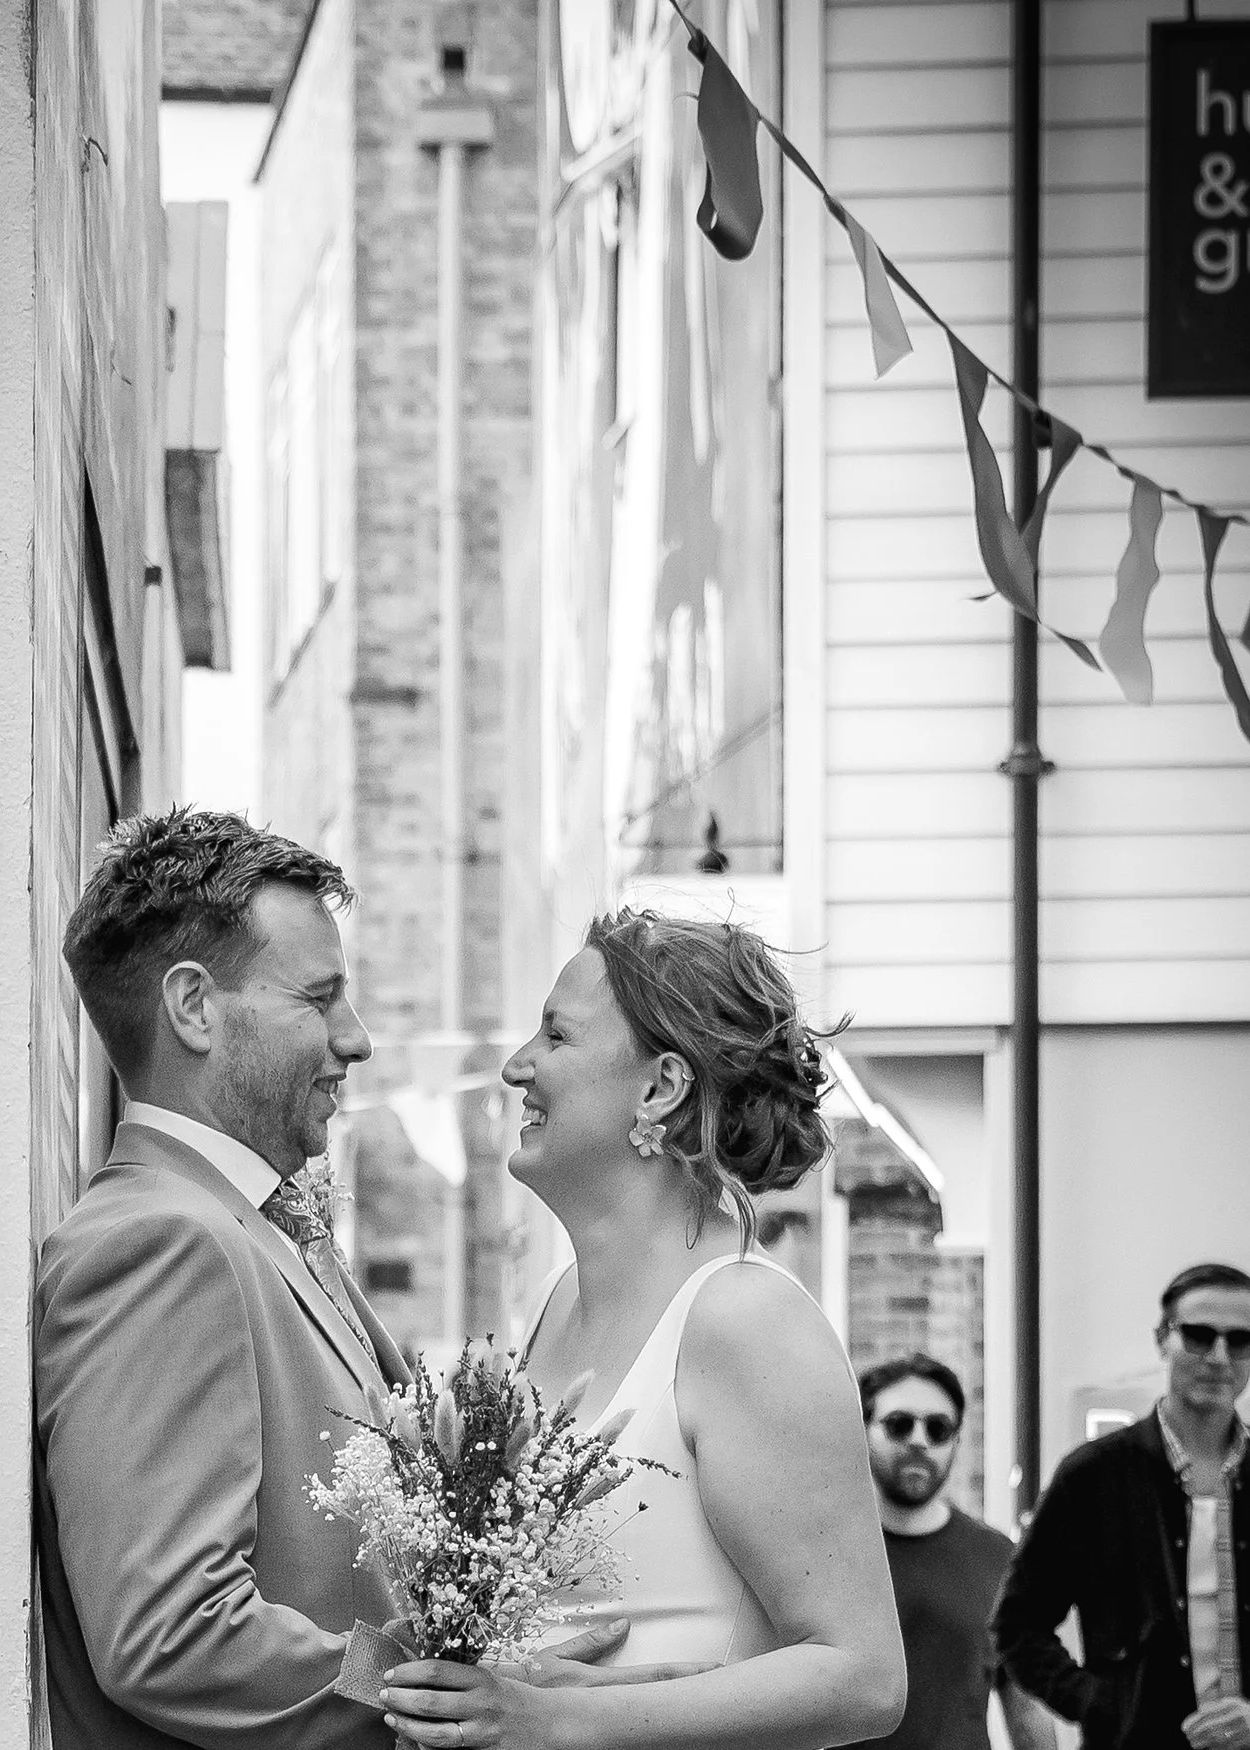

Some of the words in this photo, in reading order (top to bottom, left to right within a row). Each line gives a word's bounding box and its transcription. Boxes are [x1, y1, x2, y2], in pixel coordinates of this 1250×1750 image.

[1196, 68, 1250, 136] h
[1193, 152, 1249, 219] &
[1193, 228, 1250, 293] g
